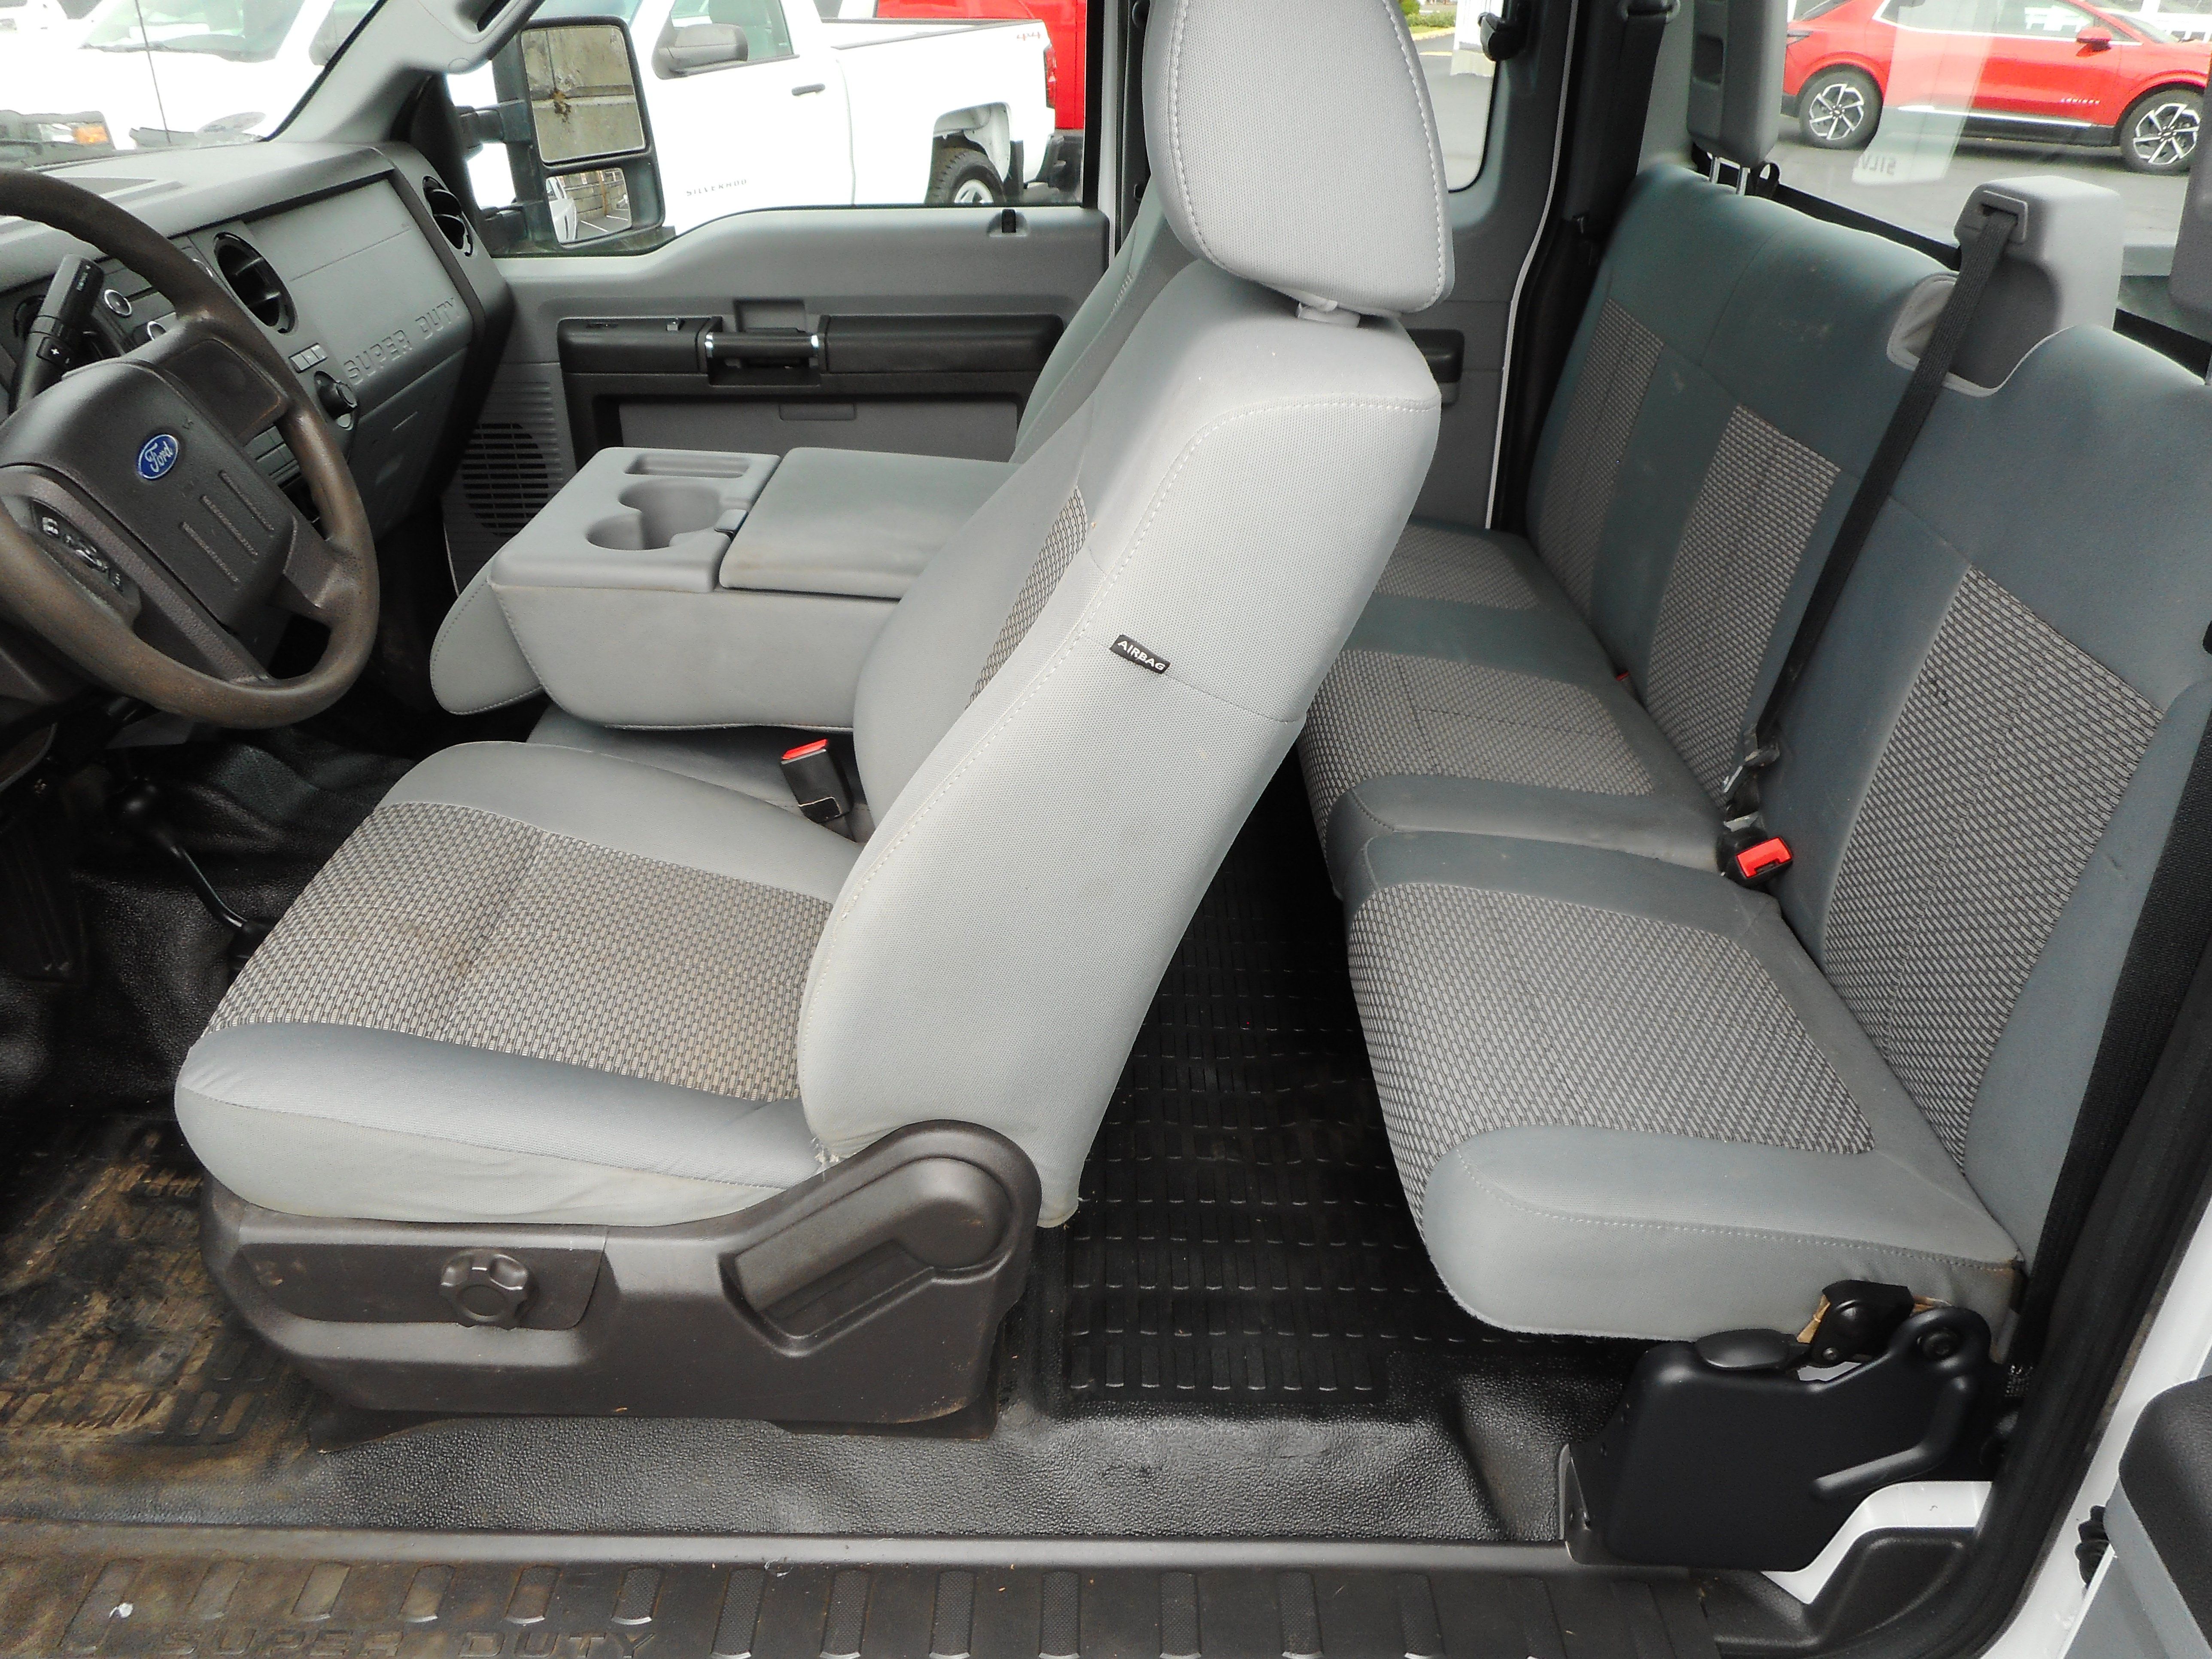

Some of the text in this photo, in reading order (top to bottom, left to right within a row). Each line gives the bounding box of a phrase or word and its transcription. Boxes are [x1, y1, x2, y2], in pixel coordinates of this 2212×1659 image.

[343, 298, 461, 386] SUPER DUTY
[144, 441, 173, 472] Ford
[1117, 641, 1165, 671] AIRBAG
[161, 1630, 656, 1659] SUPER DUTY
